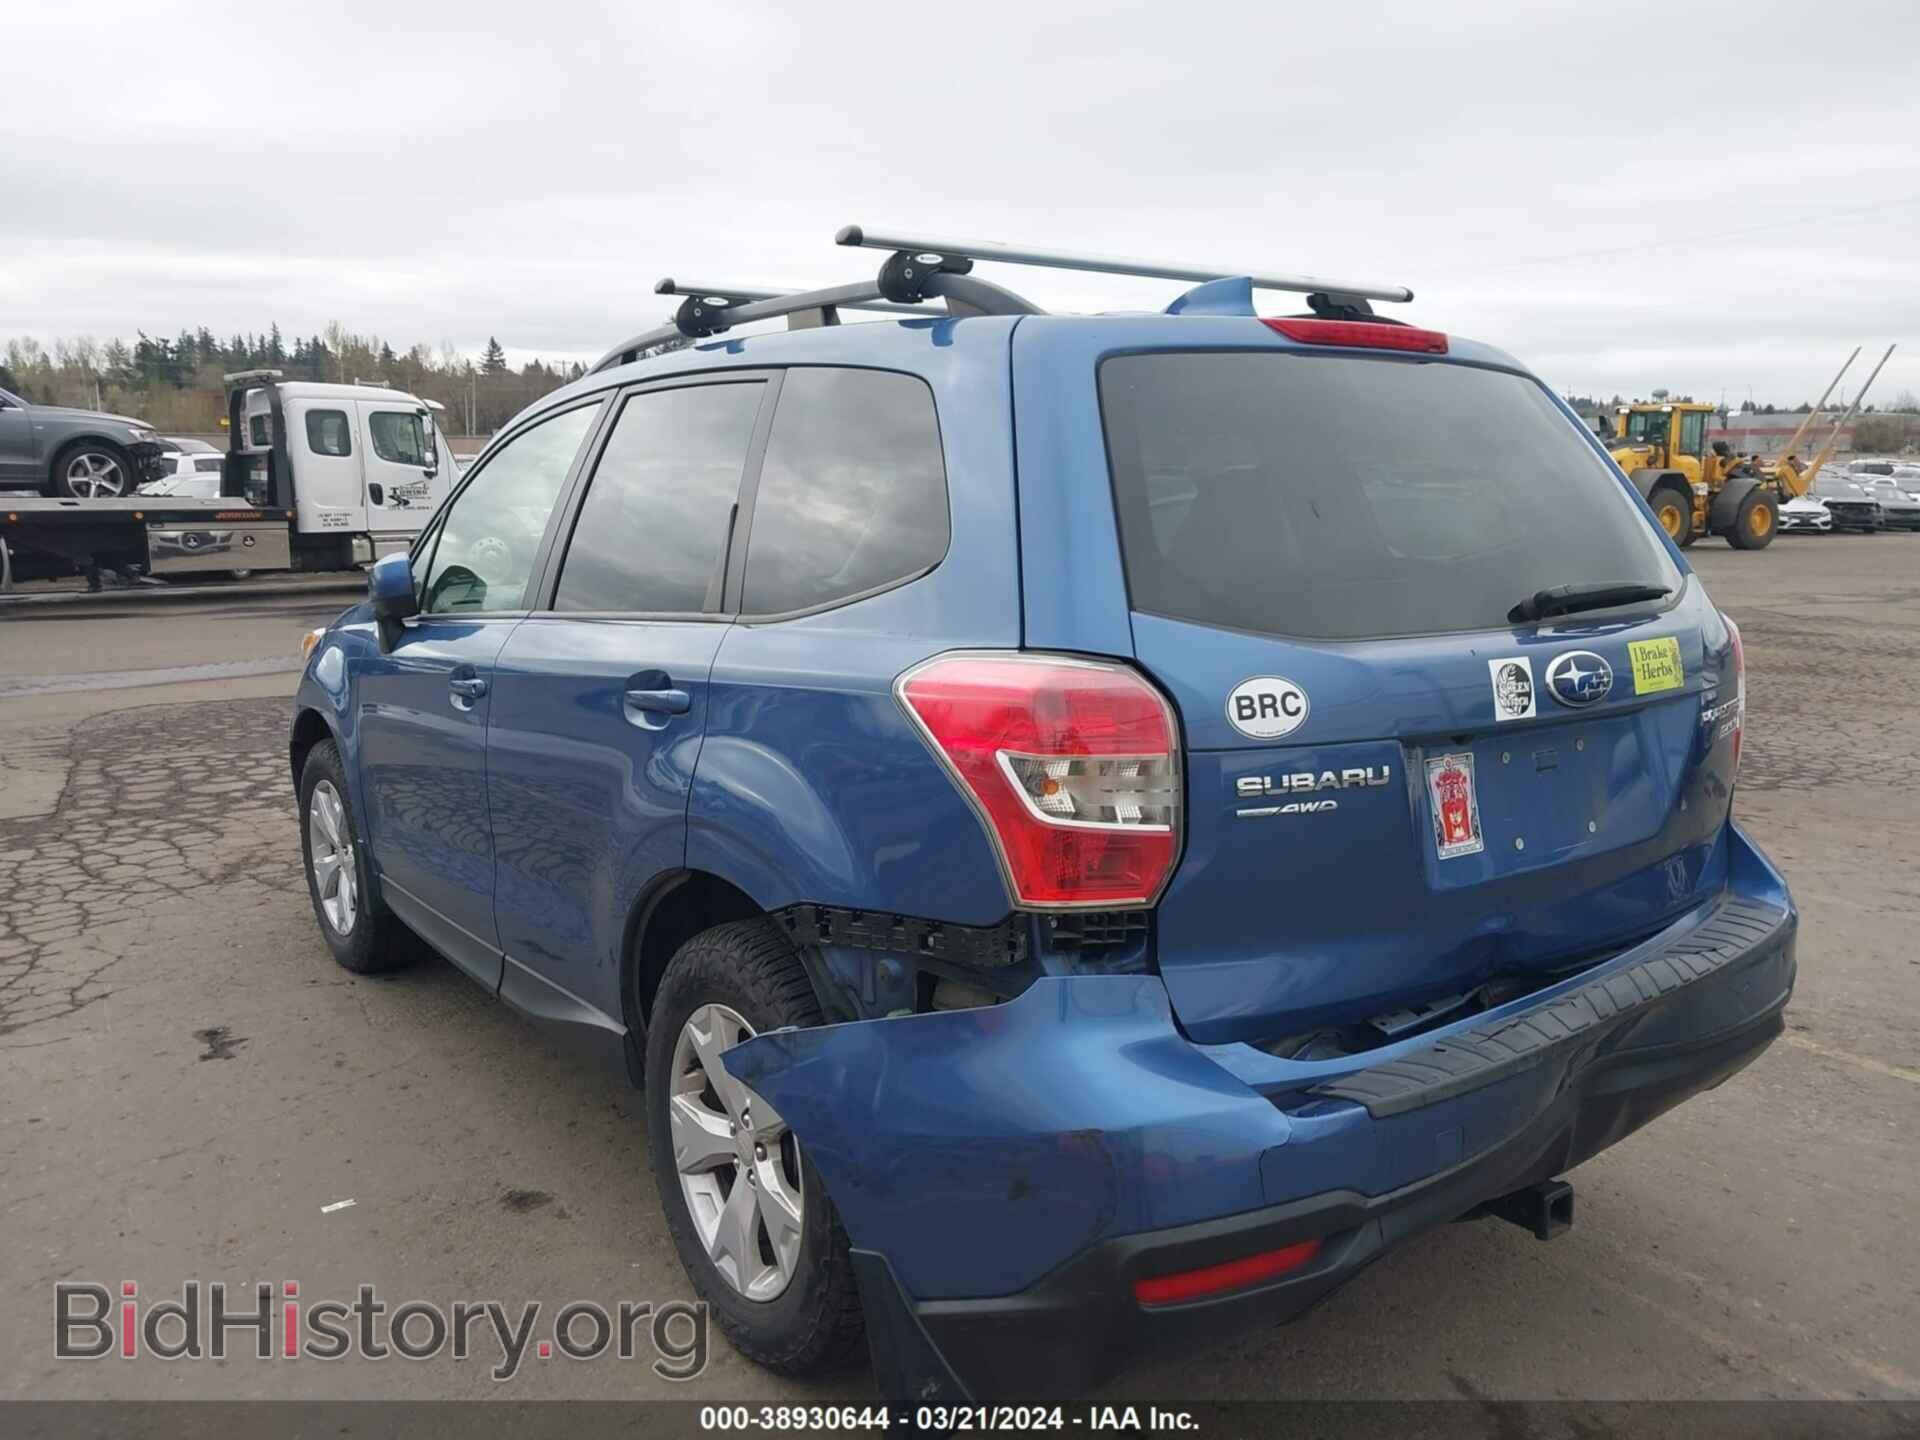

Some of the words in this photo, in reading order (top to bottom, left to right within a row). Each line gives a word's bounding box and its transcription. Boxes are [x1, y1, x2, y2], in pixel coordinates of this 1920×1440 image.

[1633, 647, 1639, 662] I
[1639, 644, 1669, 661] Brake
[1641, 661, 1673, 681] Herbs
[1235, 691, 1302, 721] BRC
[1236, 765, 1390, 797] SUBARU
[1279, 799, 1339, 814] AWD
